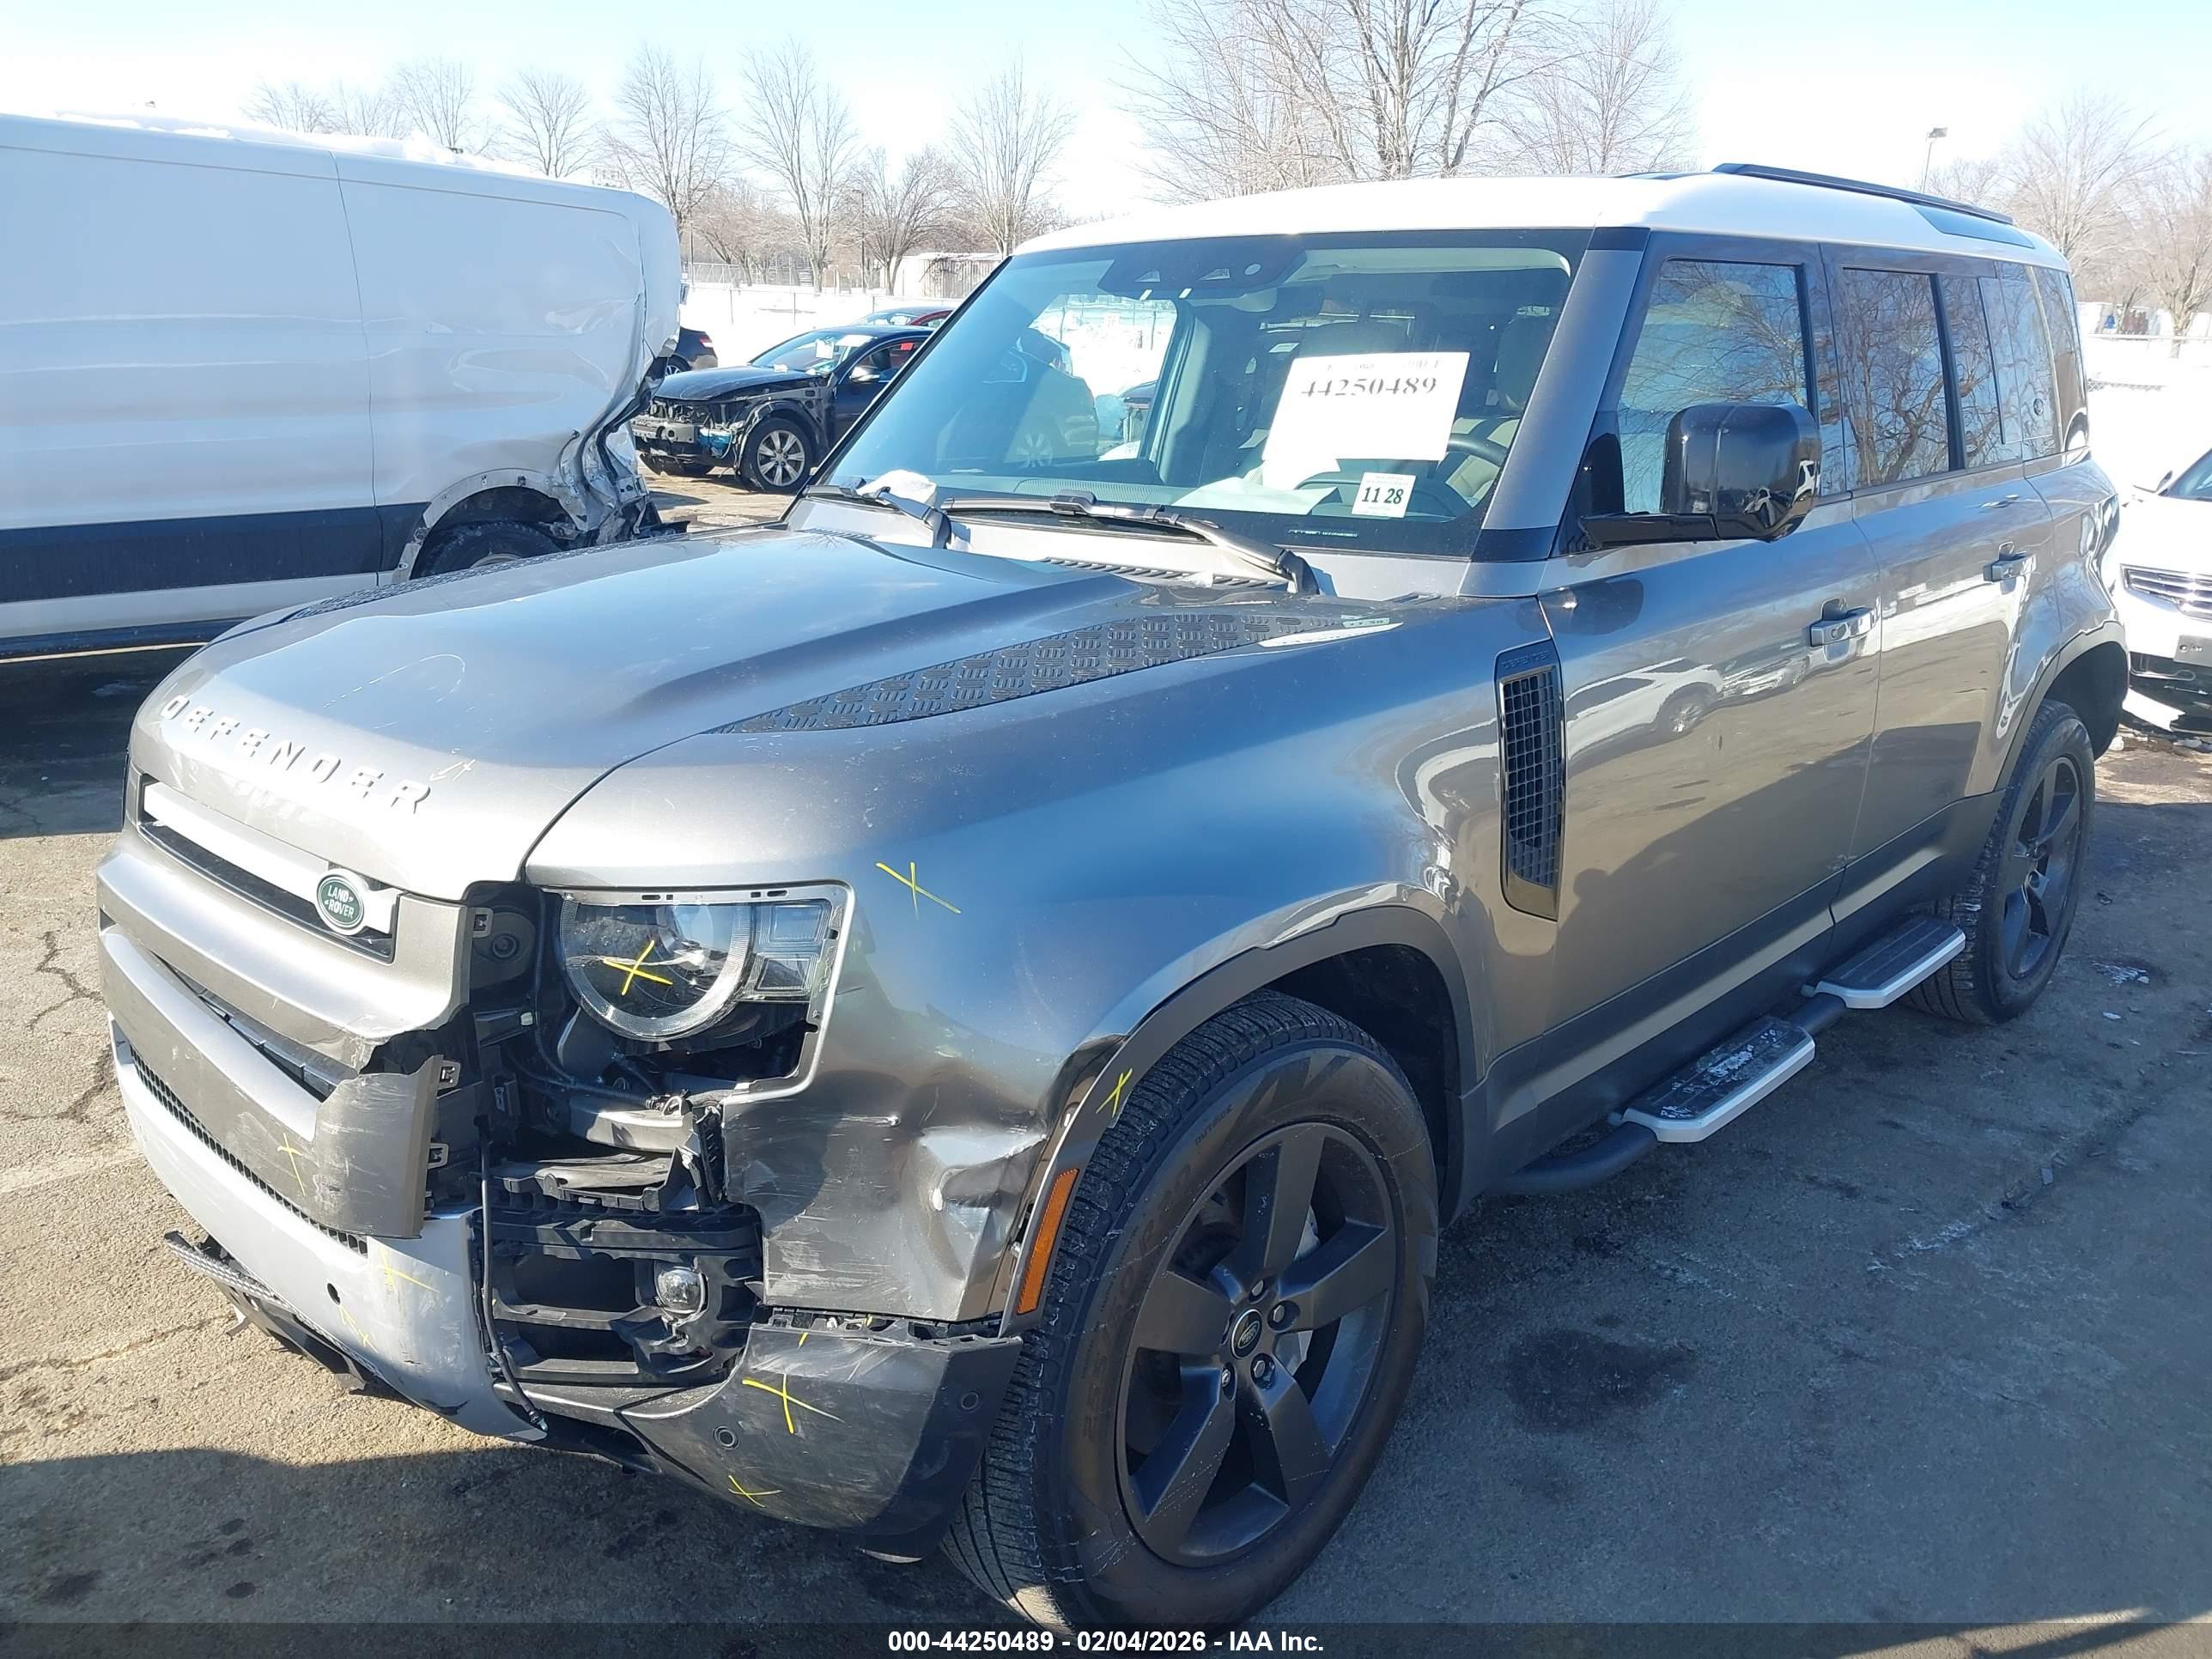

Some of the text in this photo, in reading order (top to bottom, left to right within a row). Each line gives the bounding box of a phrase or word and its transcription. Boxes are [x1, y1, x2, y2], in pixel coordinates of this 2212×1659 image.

[1301, 377, 1437, 398] 44250489
[1362, 486, 1404, 505] 11 28
[160, 694, 431, 815] DEFENDER
[327, 885, 350, 903] LAND
[328, 899, 355, 920] ROVER
